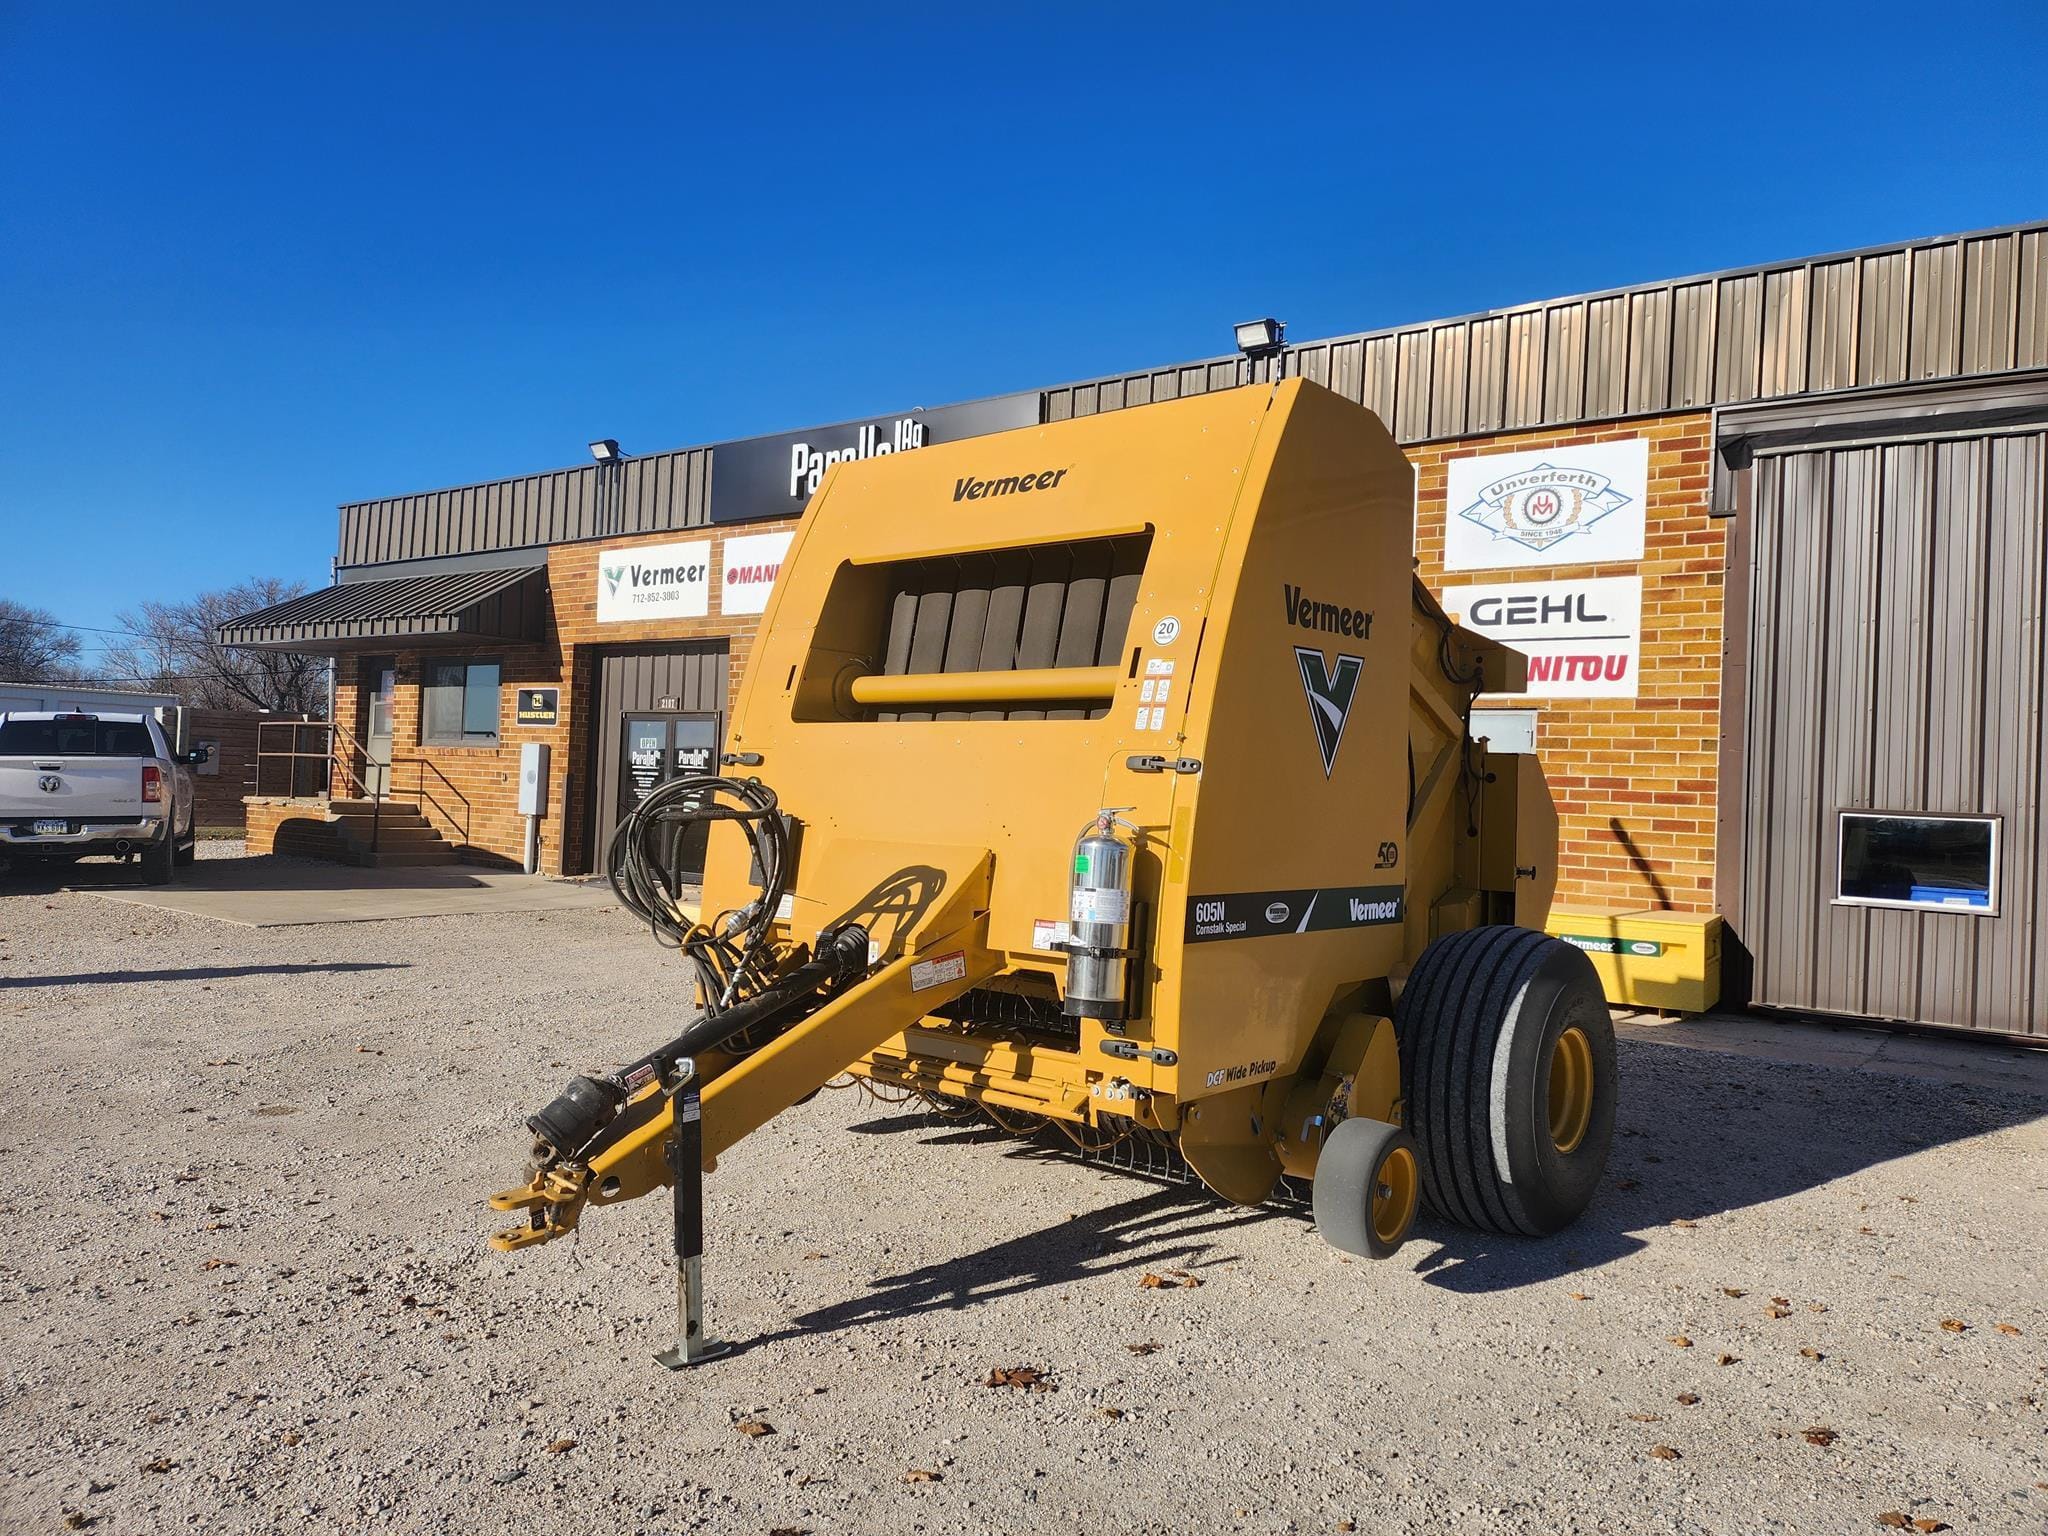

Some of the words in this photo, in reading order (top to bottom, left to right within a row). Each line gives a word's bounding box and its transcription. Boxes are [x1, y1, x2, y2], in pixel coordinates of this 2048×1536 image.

[953, 468, 1068, 502] Vermeer
[1490, 471, 1597, 496] Unverferth
[631, 563, 706, 588] Vermeer
[1284, 584, 1373, 640] Vermeer
[1469, 593, 1608, 626] GEHL
[1158, 622, 1175, 635] 20
[1527, 654, 1629, 682] NITOU
[519, 711, 555, 719] HUSTLER
[1196, 902, 1225, 923] 605N
[1349, 898, 1400, 922] Vermeer
[1196, 923, 1225, 936] Cornstalk
[1226, 921, 1247, 934] Special
[1226, 1066, 1247, 1082] Wide
[1249, 1060, 1276, 1077] Pickup
